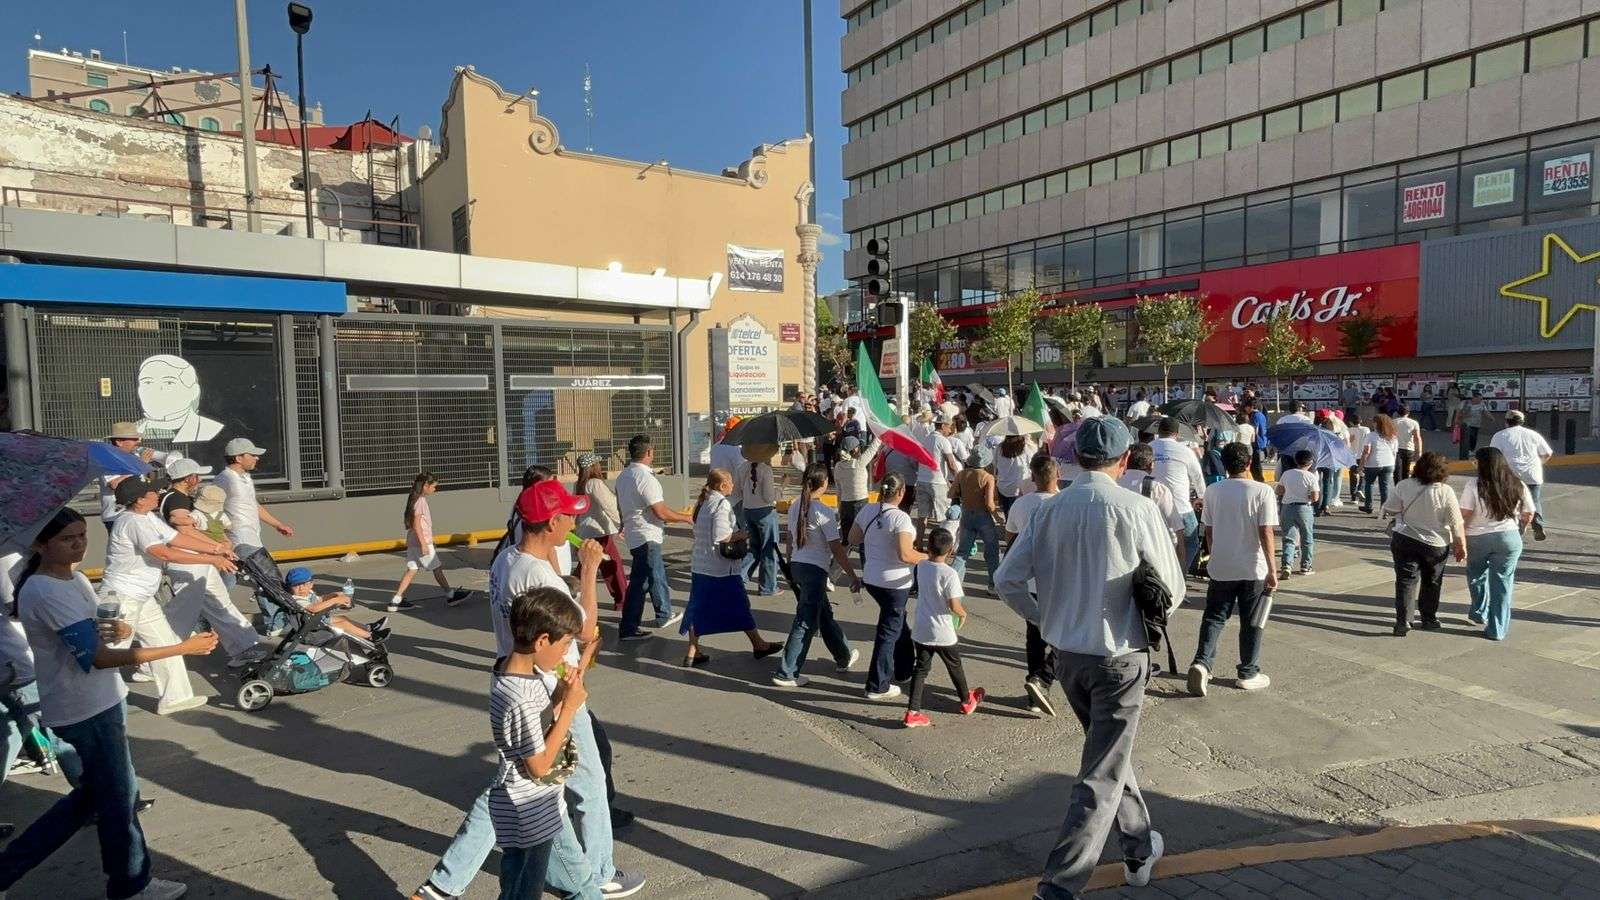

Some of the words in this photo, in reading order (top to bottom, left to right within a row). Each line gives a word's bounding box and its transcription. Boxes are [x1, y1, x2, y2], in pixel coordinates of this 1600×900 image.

[1545, 161, 1588, 180] RENTA
[1405, 184, 1444, 201] RENTO
[730, 270, 746, 280] 614
[1232, 291, 1314, 329] Carl's
[1314, 286, 1363, 323] Jr.
[738, 329, 761, 339] telcel
[728, 345, 768, 356] OFERTAS
[571, 377, 612, 387] JUÁREZ
